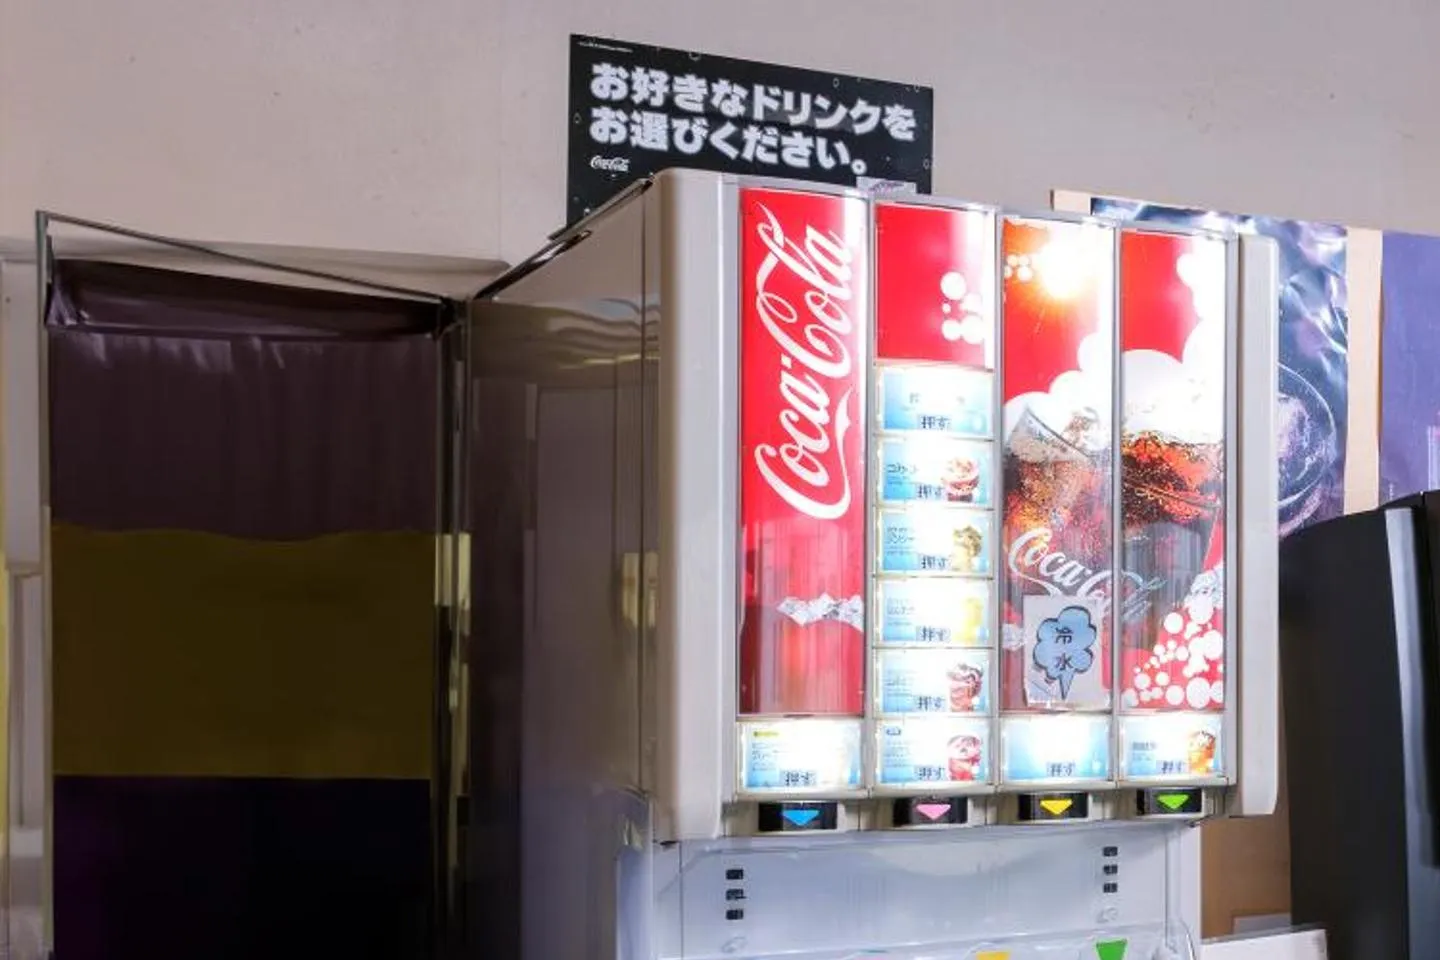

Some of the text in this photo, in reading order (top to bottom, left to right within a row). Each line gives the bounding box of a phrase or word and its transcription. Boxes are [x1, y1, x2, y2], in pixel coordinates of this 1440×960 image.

[590, 62, 917, 141] お好きなドリンクを
[590, 106, 868, 175] お選びください。
[754, 199, 853, 520] Coca-Cola
